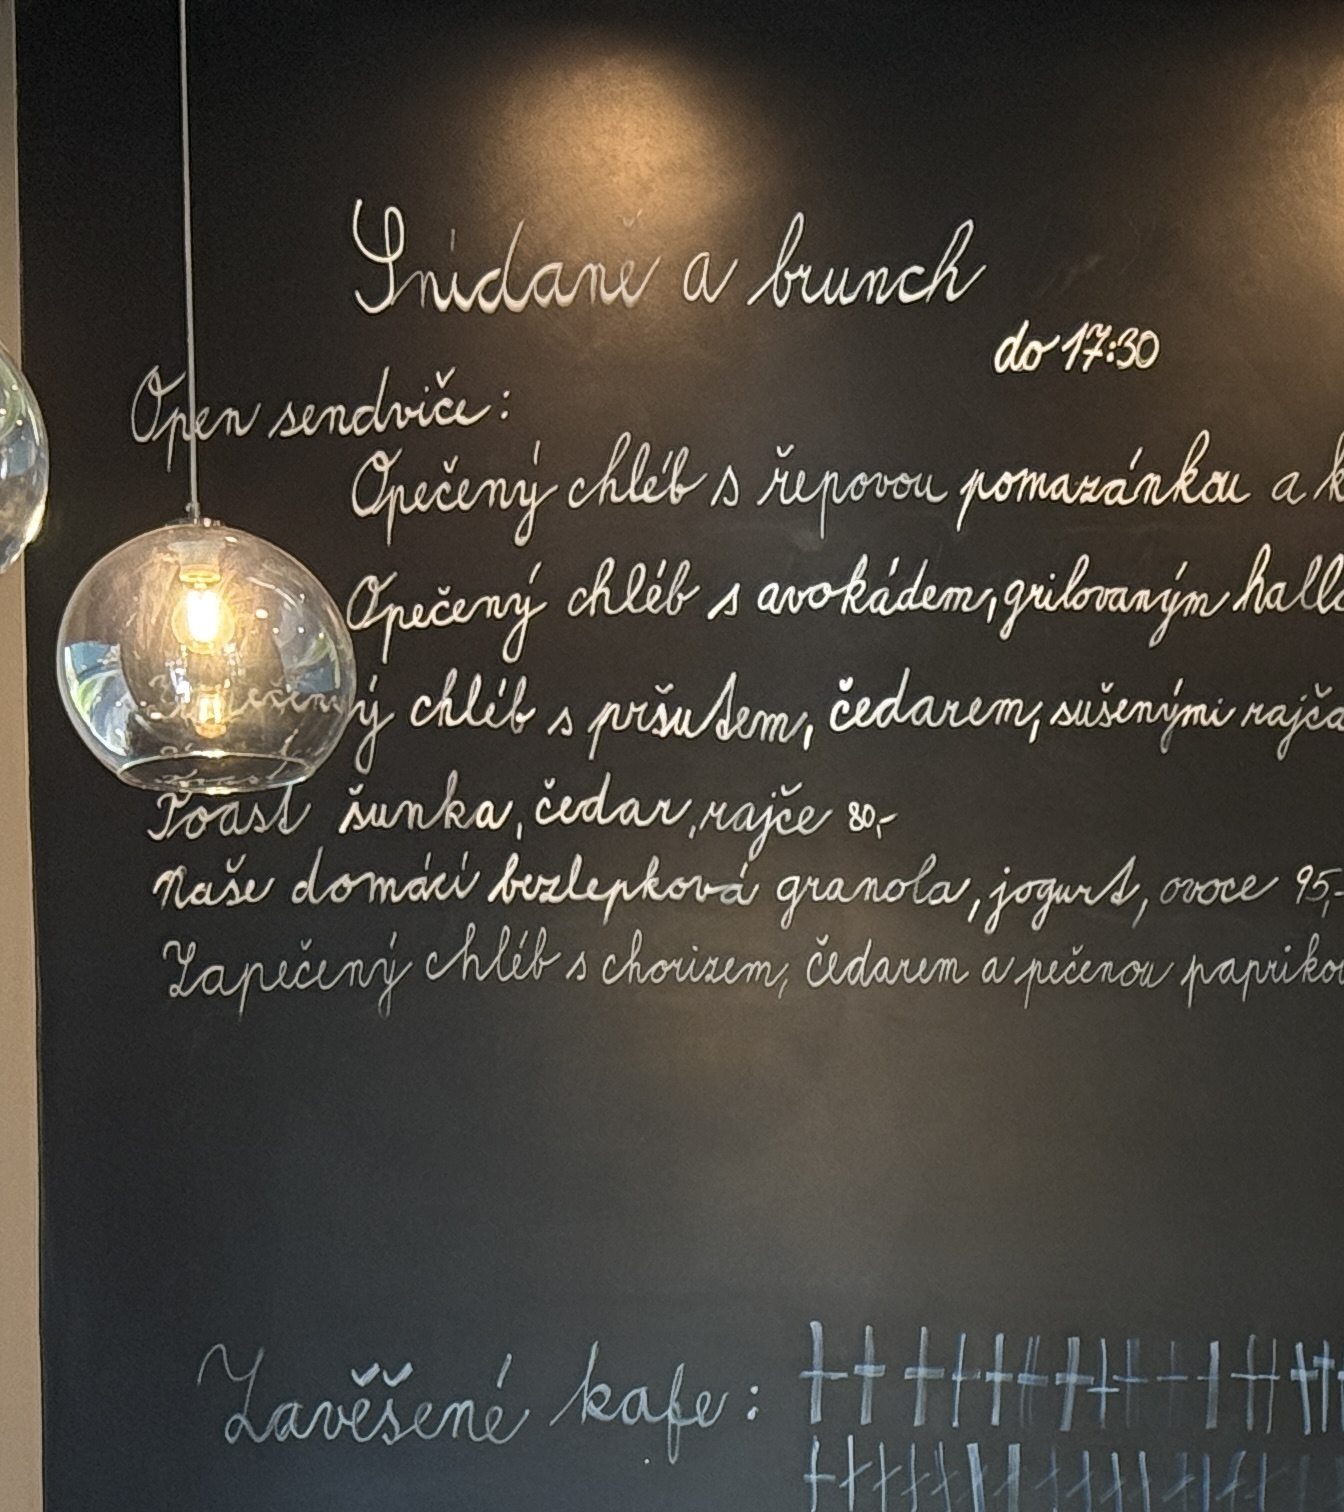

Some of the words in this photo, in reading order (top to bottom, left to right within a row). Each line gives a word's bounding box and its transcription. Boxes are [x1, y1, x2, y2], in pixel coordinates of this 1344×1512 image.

[353, 199, 659, 314] Snídaně
[682, 251, 738, 303] a
[747, 212, 986, 307] brunch
[994, 320, 1060, 372] do
[1061, 322, 1160, 371] 17:30
[131, 366, 261, 473] Open
[351, 440, 558, 547] Opečený
[567, 431, 708, 509] chléb
[709, 462, 739, 508] s
[757, 444, 948, 539] řepovou
[955, 430, 1251, 532] pomazánkou
[1270, 470, 1309, 504] a
[347, 561, 546, 664] Opečený
[567, 556, 700, 617] chléb
[709, 580, 741, 620] s
[756, 553, 995, 625] avokádem,
[1003, 553, 1233, 648] grilovaným
[411, 669, 536, 733] chléb
[549, 700, 576, 736] s
[589, 674, 812, 760] pršutem,
[830, 668, 1042, 742] čedarem,
[1050, 678, 1239, 754] sušenými
[147, 785, 311, 841] Toast
[339, 770, 522, 841] šunka,
[536, 773, 697, 838] čedar,
[700, 782, 833, 861] rajče
[152, 853, 275, 908] Naše
[291, 847, 480, 905] domácí
[487, 852, 761, 925] bezlepková
[777, 854, 984, 929] granola,
[987, 856, 1149, 933] jogurt,
[1161, 873, 1279, 905] ovoce
[161, 931, 412, 1022] Zapečený
[425, 923, 564, 983] chléb
[566, 950, 589, 981] s
[602, 929, 791, 1000] chorizem,
[806, 939, 970, 986] čedarem
[981, 954, 1019, 986] a
[1017, 946, 1174, 1008] pečenou
[197, 1342, 530, 1446] Zavěšené
